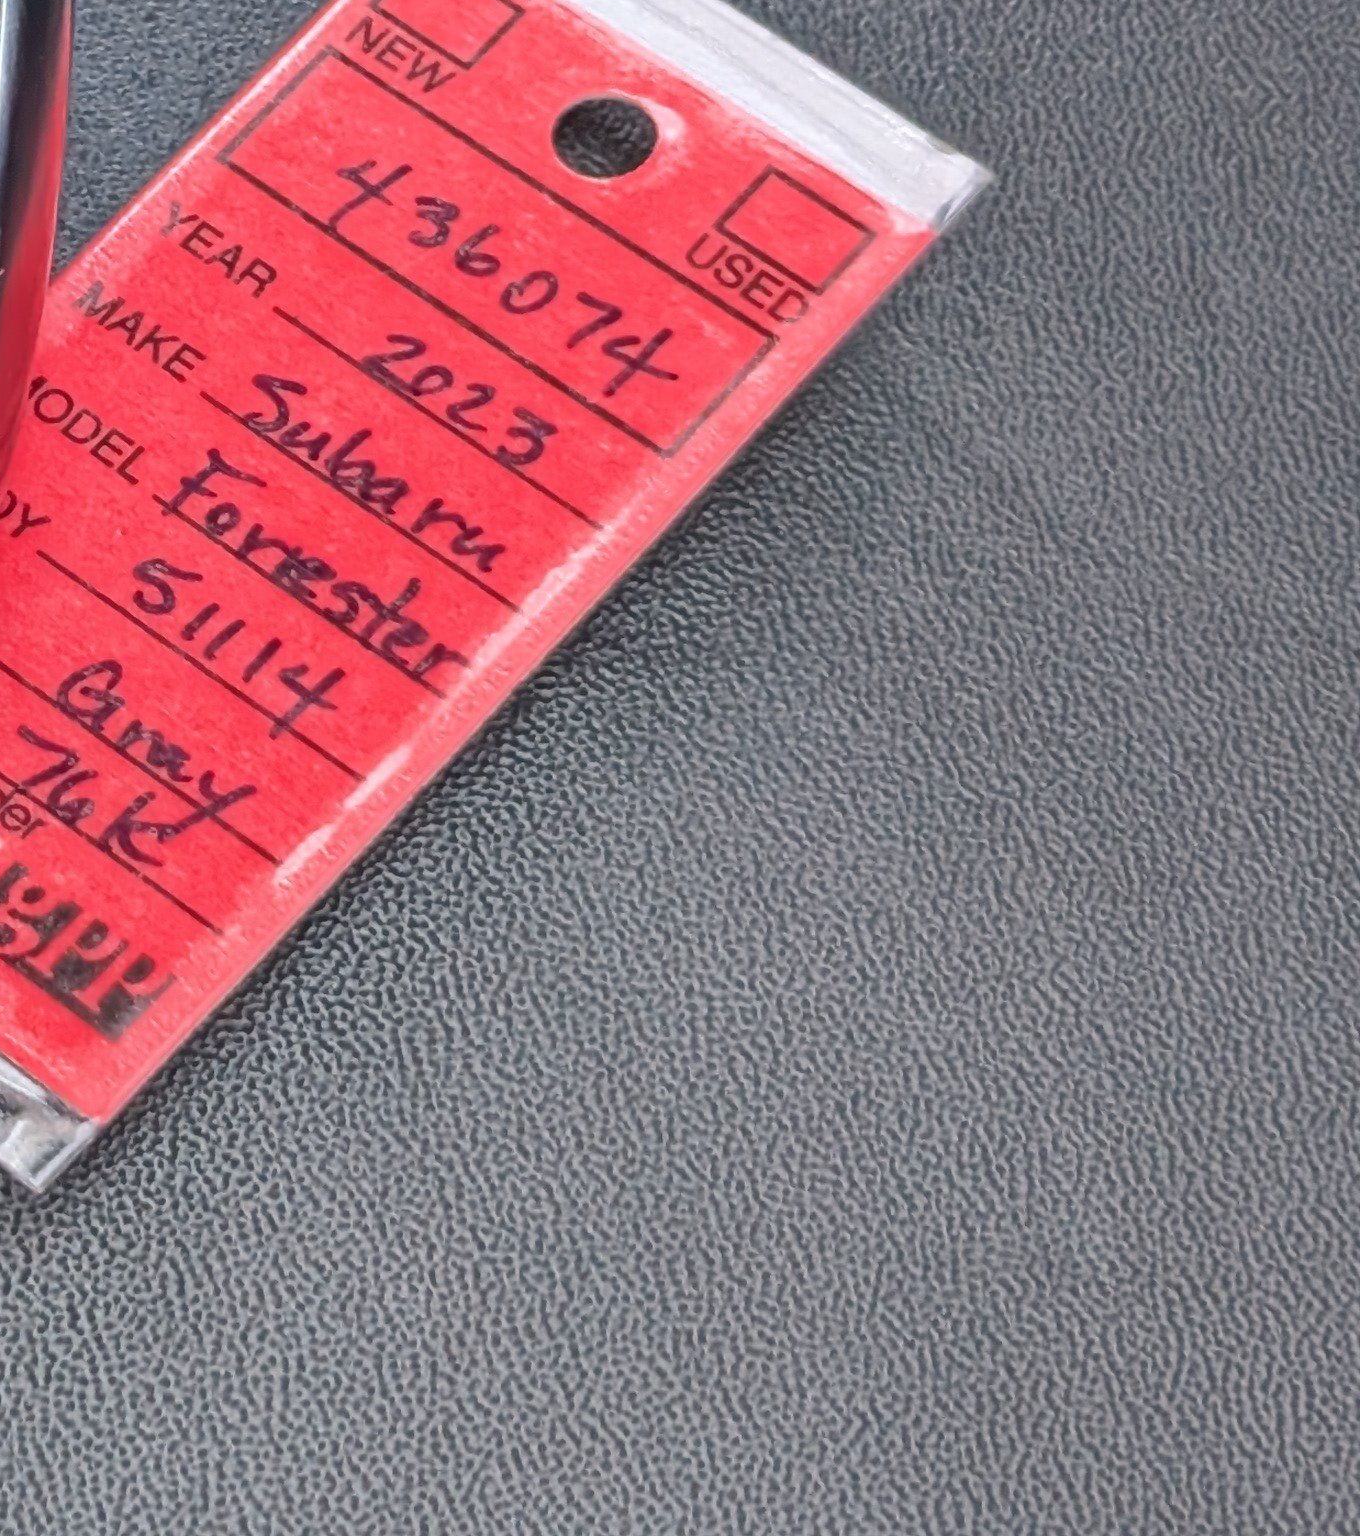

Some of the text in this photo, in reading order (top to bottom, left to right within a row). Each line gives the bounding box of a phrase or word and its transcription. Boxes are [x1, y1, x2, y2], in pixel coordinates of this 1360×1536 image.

[347, 18, 456, 95] NEW
[160, 201, 276, 298] YEAR
[336, 159, 679, 398] 436074
[685, 230, 811, 324] USED
[74, 281, 206, 383] MAKE
[361, 332, 555, 466] 2023
[239, 371, 507, 575] Subaru
[180, 448, 469, 676] Forester
[132, 558, 346, 737] 51114
[17, 725, 162, 866] 76K
[57, 659, 257, 841] Gray
